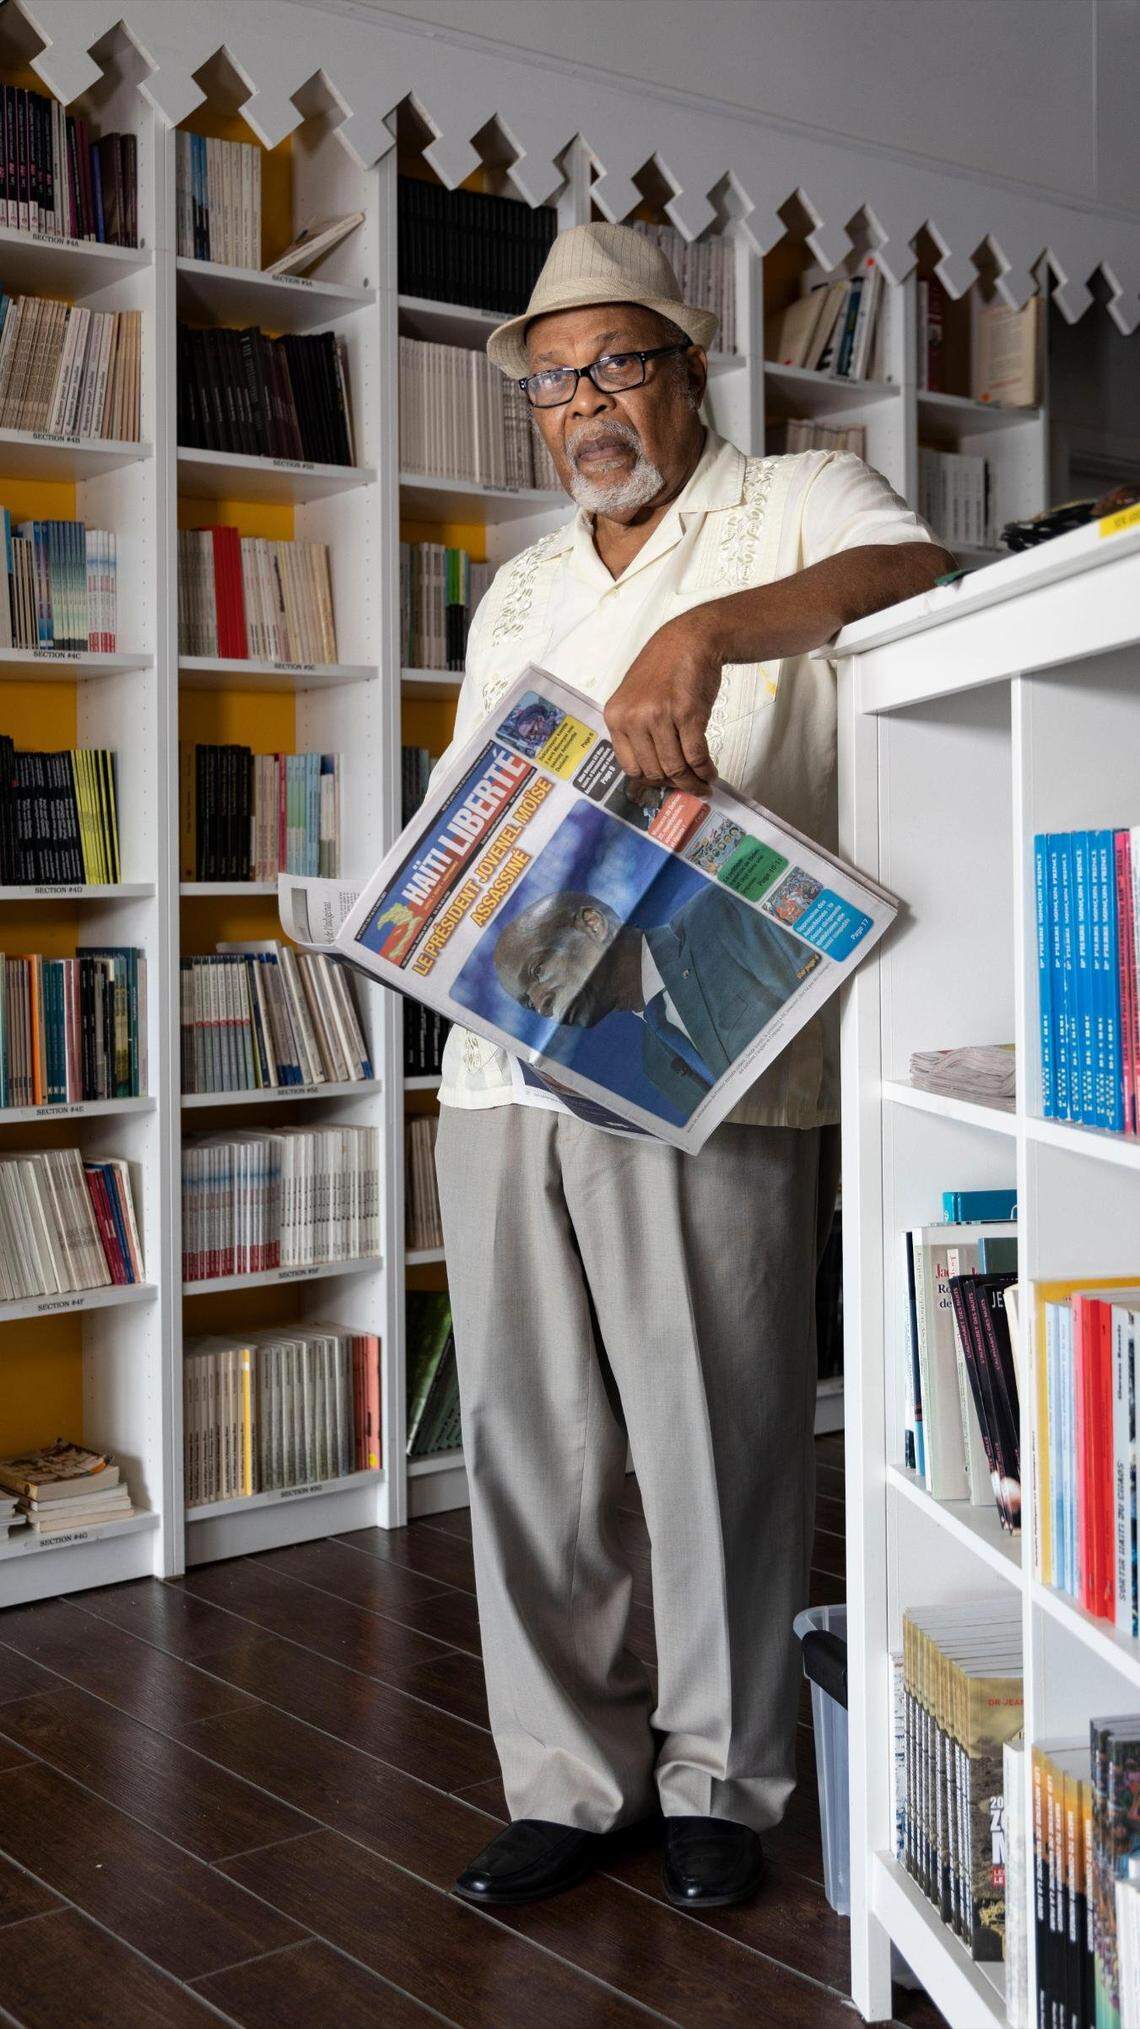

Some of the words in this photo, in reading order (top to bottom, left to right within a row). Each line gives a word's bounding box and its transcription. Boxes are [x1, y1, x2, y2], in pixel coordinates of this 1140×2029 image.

[32, 234, 64, 244] SECTION
[272, 275, 301, 284] SECTION
[33, 432, 64, 442] SECTION
[67, 436, 80, 444] #4B
[273, 459, 300, 468] SECTION
[33, 651, 65, 659] SECTION
[599, 769, 613, 785] Page
[401, 845, 453, 907] HAÏTI
[437, 745, 526, 858] LIBERTÉ
[411, 953, 434, 977] LE
[423, 876, 483, 958] PRÉSIDENT
[471, 817, 523, 884] JOVENEL
[512, 774, 553, 825] MOÏSE
[469, 845, 531, 928] ASSASSINÉ
[849, 925, 864, 941] Page
[277, 1088, 305, 1096] SECTION
[36, 1107, 68, 1115] SECTION
[279, 1269, 304, 1279] SECTION
[953, 1287, 961, 1305] NUITS
[992, 1291, 1003, 1308] JE
[38, 1301, 69, 1311] SECTION
[281, 1488, 309, 1497] SECTION
[40, 1534, 72, 1546] SECTION
[1118, 1558, 1126, 1601] SORTIR
